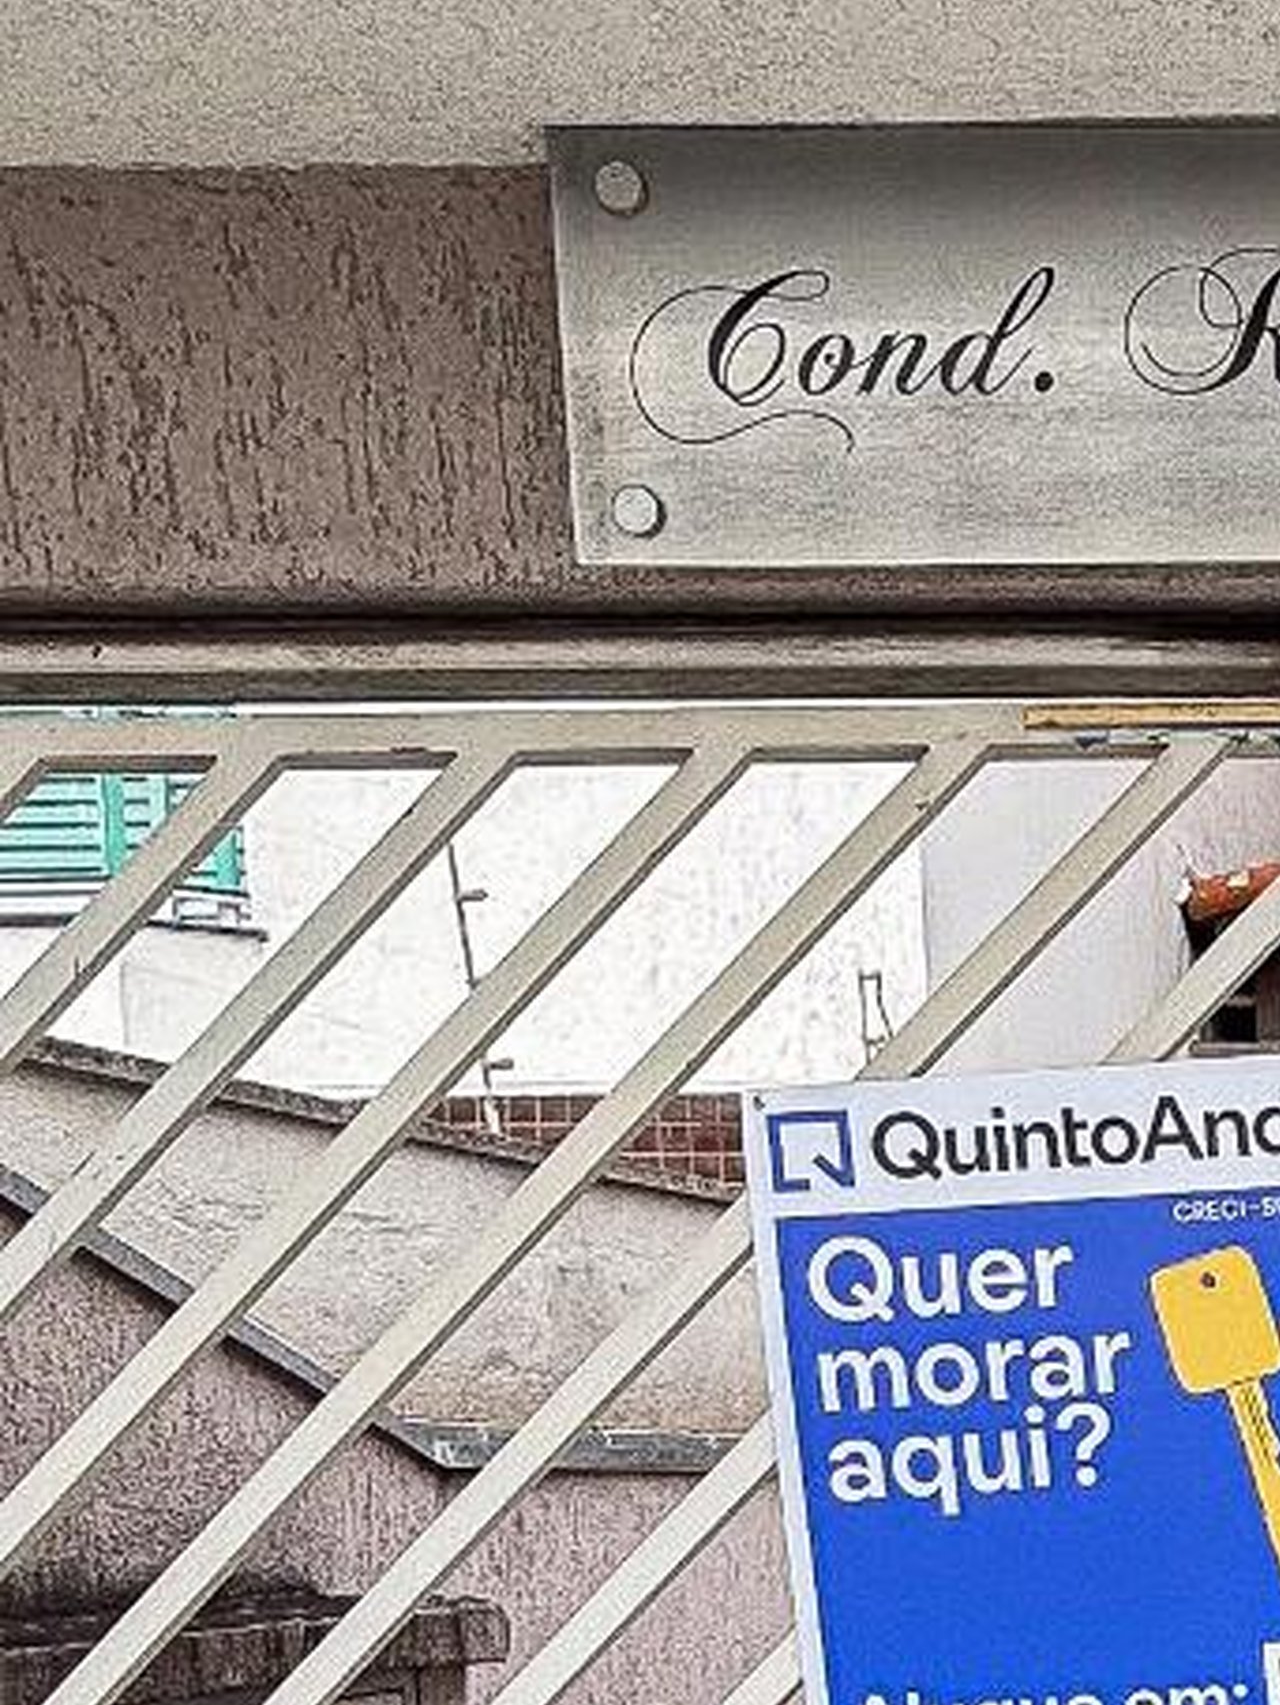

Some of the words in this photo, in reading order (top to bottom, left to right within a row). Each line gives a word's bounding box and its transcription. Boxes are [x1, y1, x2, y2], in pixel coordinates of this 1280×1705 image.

[629, 266, 1056, 453] Cond.
[805, 1233, 1075, 1324] Quer
[817, 1328, 1131, 1414] morar
[827, 1401, 1113, 1518] aqui?
